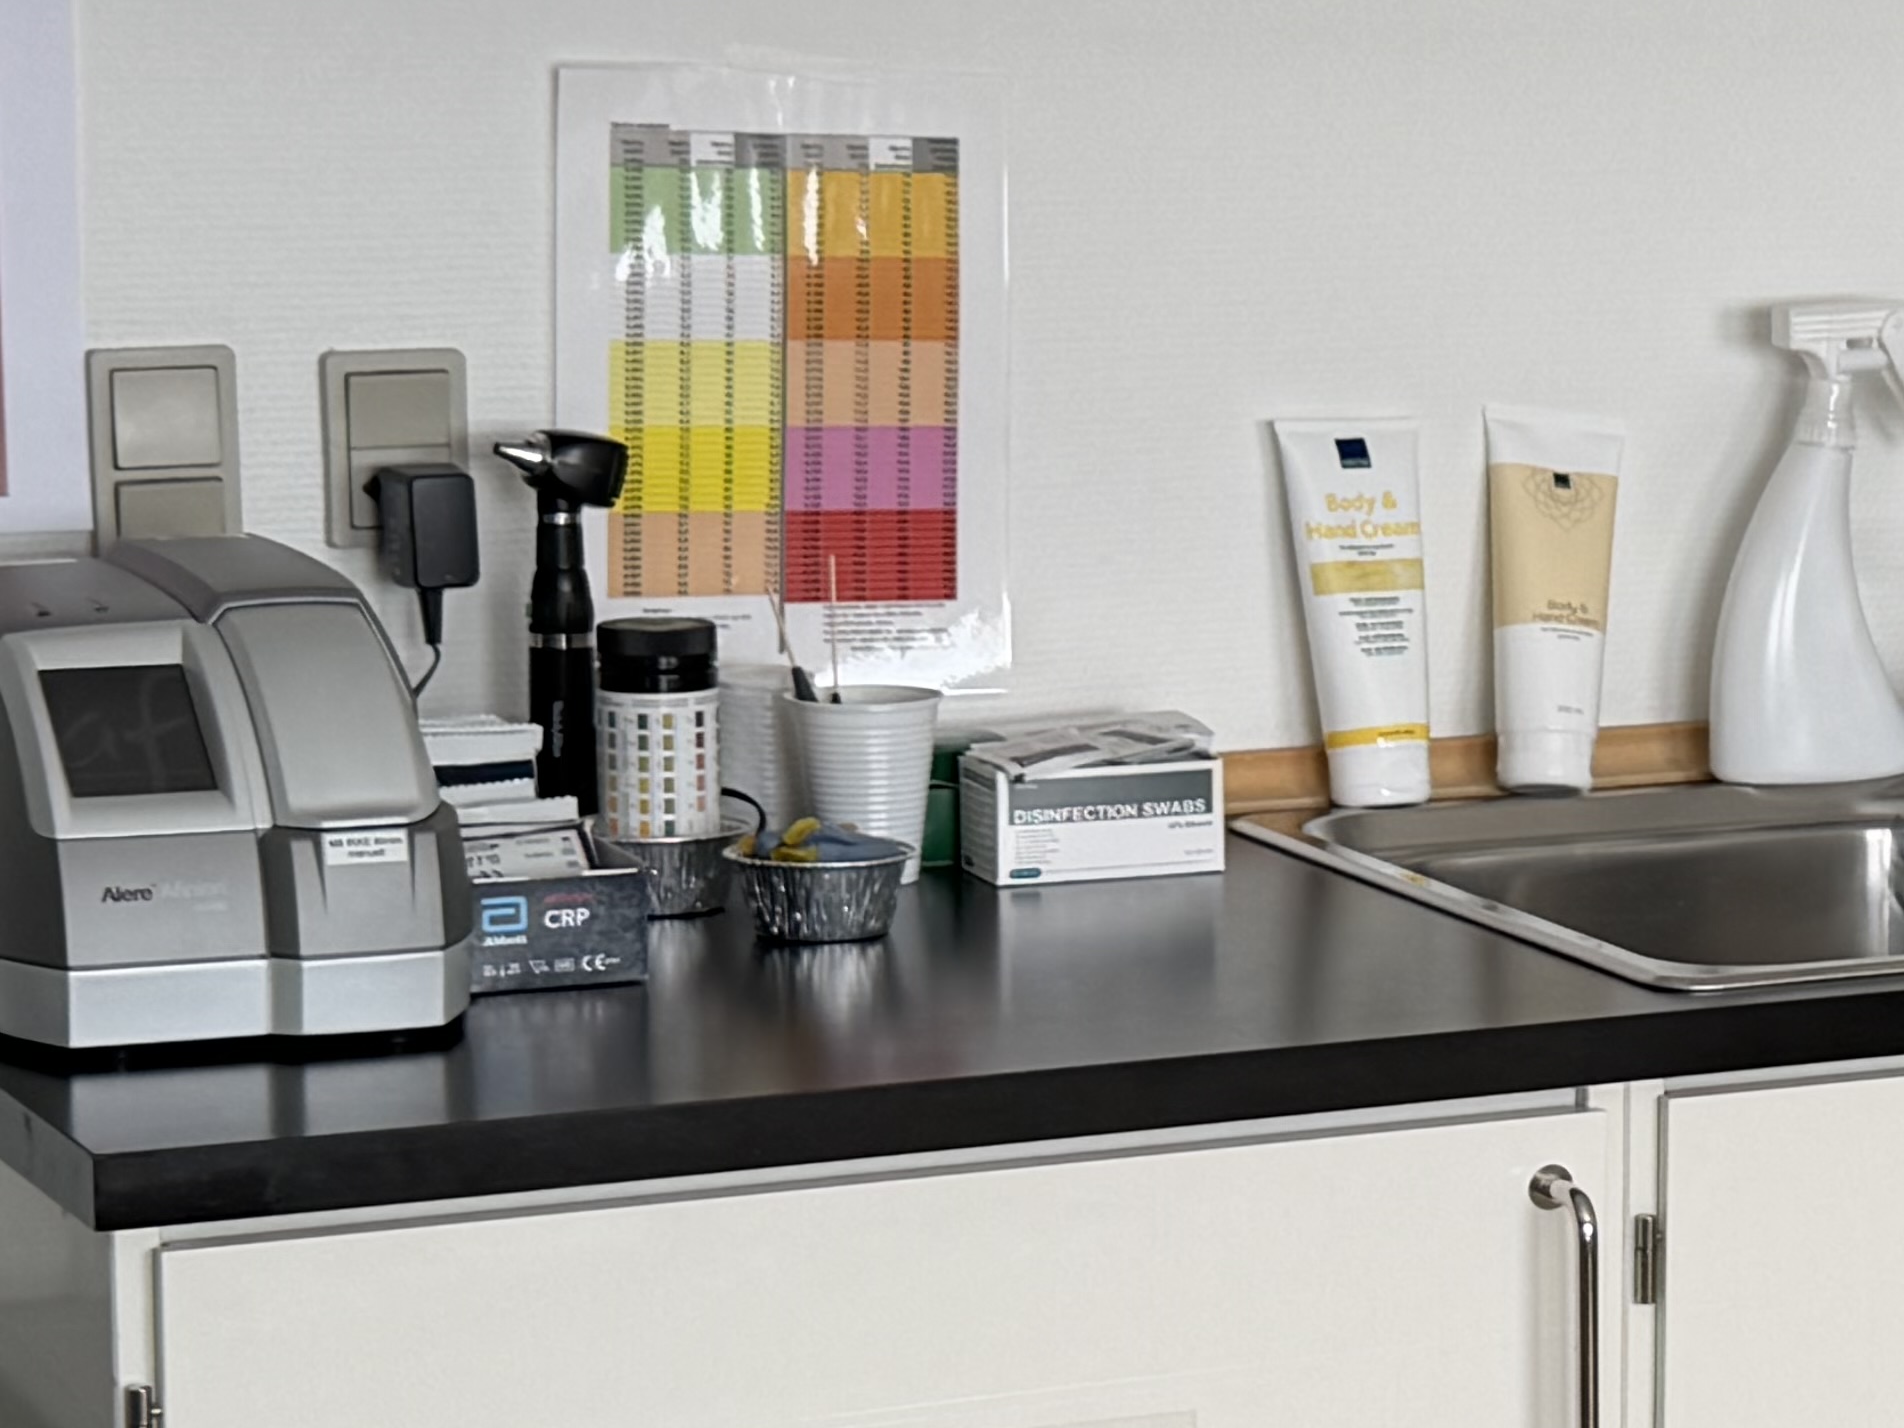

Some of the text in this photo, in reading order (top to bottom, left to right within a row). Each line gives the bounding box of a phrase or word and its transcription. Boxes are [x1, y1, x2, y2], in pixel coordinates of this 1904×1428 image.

[1325, 492, 1376, 516] Body
[1013, 798, 1206, 825] DISINFECTION SWABS
[544, 908, 590, 928] CRP
